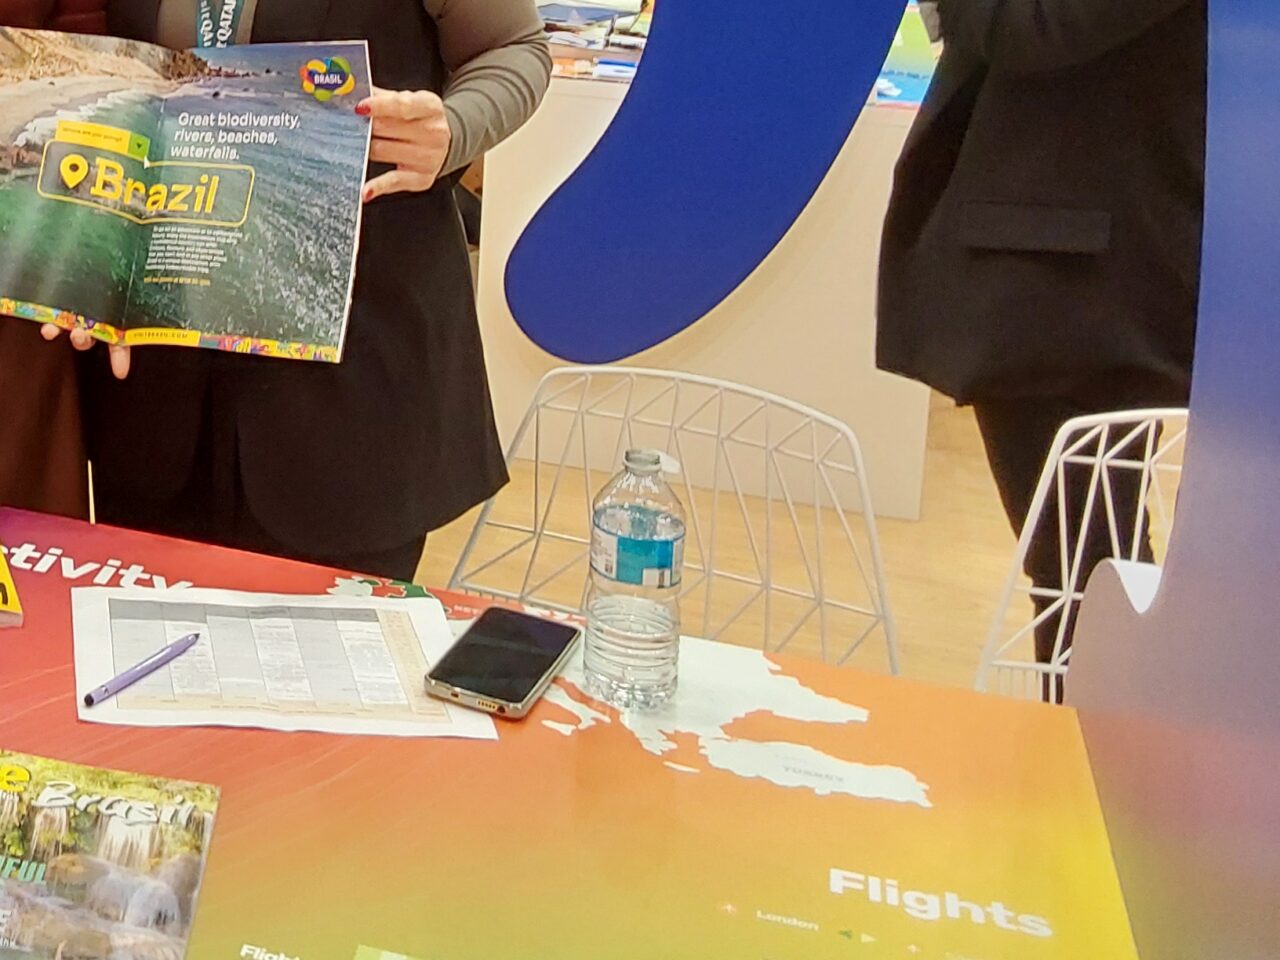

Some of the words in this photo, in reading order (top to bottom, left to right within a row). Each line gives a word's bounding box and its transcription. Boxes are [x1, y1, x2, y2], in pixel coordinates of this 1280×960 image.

[313, 73, 342, 85] BRASIL
[178, 112, 215, 127] Great
[217, 111, 301, 130] biodiversity,
[174, 130, 216, 145] rivers,
[217, 130, 279, 146] beaches,
[170, 144, 240, 160] waterfalls.
[90, 156, 220, 213] Brazil
[829, 867, 1053, 938] Flights
[756, 909, 820, 932] London
